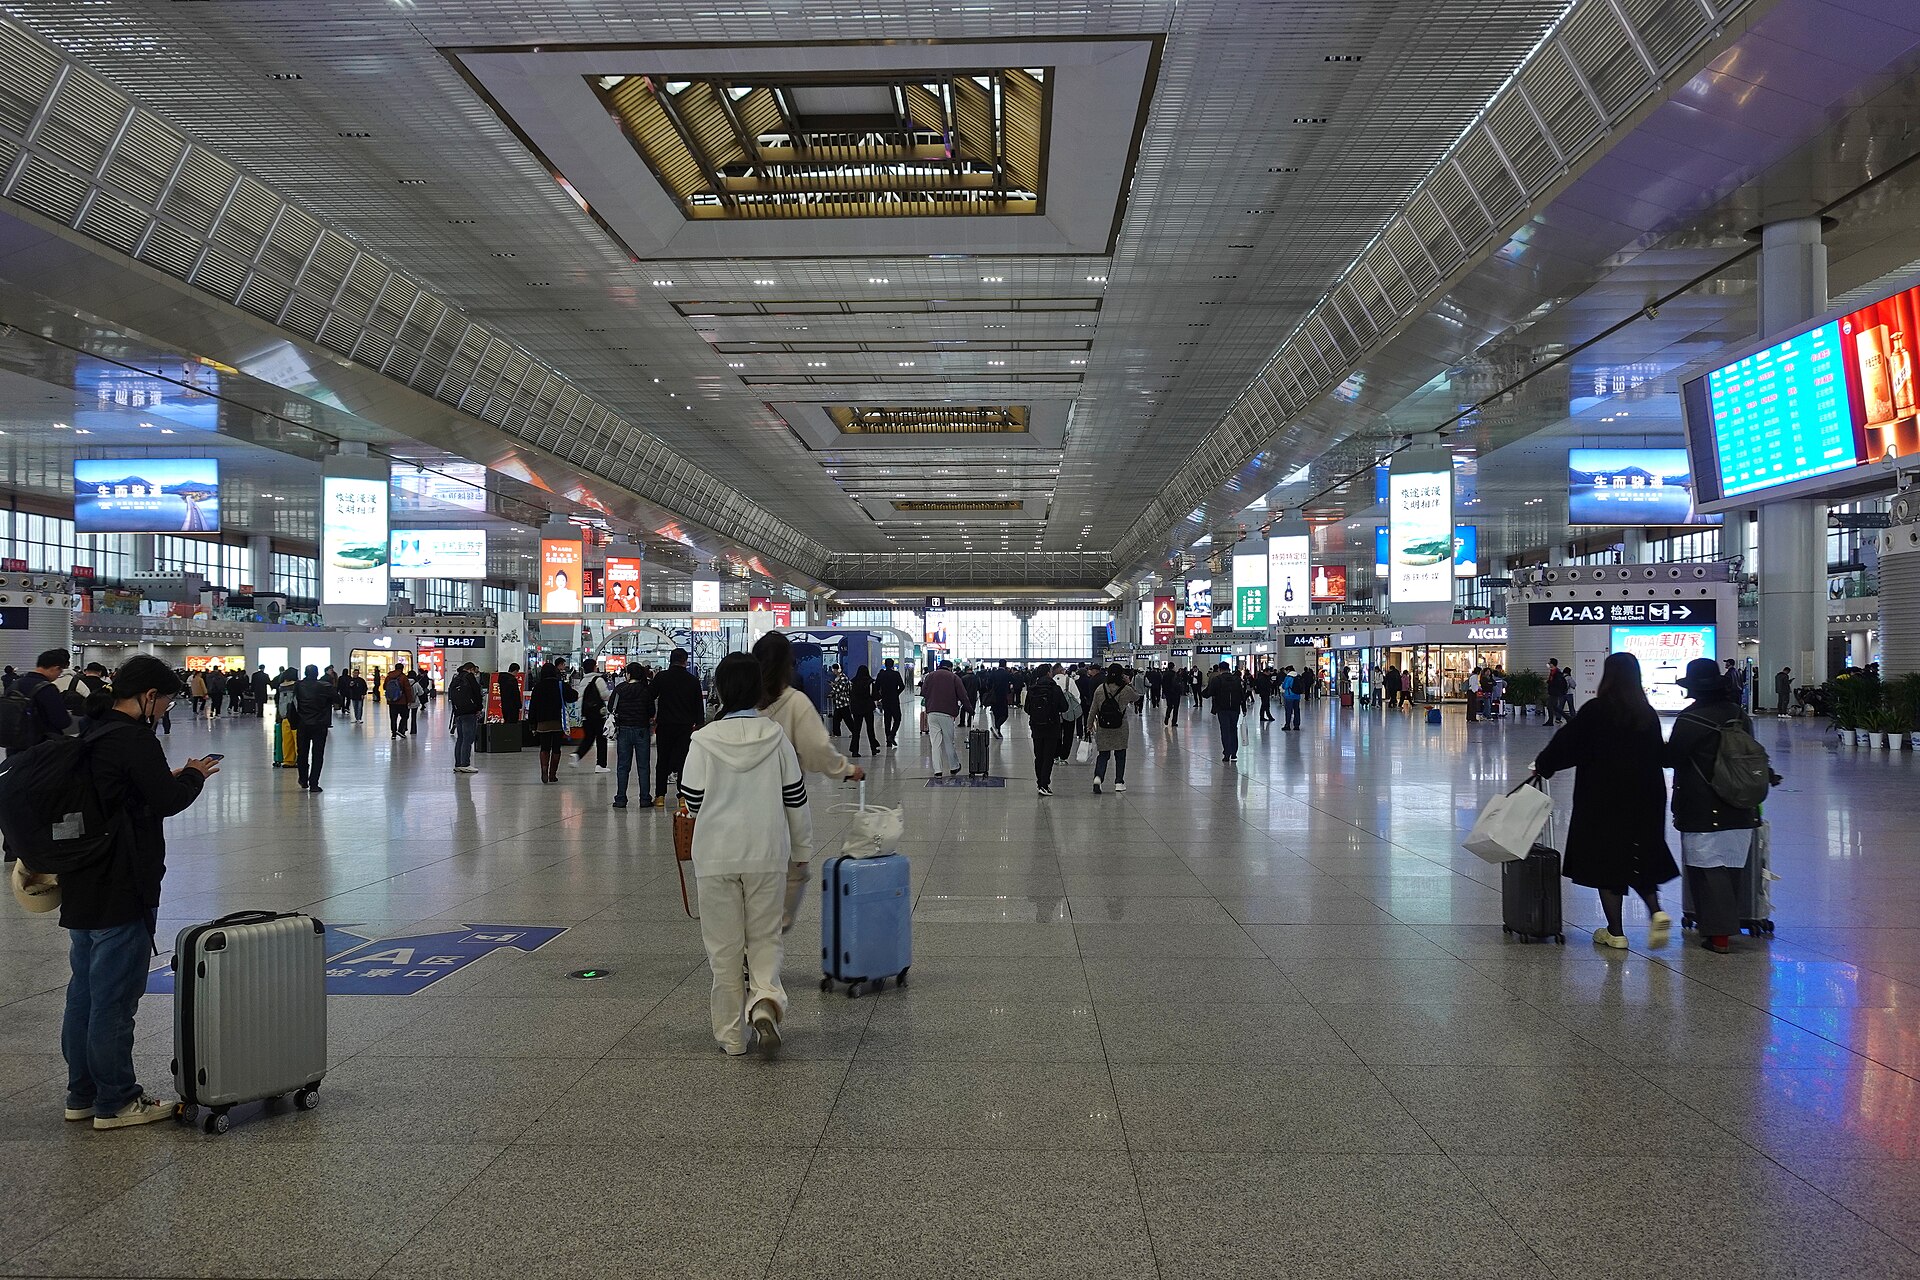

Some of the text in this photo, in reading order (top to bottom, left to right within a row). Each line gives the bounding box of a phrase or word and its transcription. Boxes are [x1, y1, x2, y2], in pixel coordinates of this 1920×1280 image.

[1550, 604, 1645, 621] A2-A3 检票口
[447, 638, 476, 646] B4-B7
